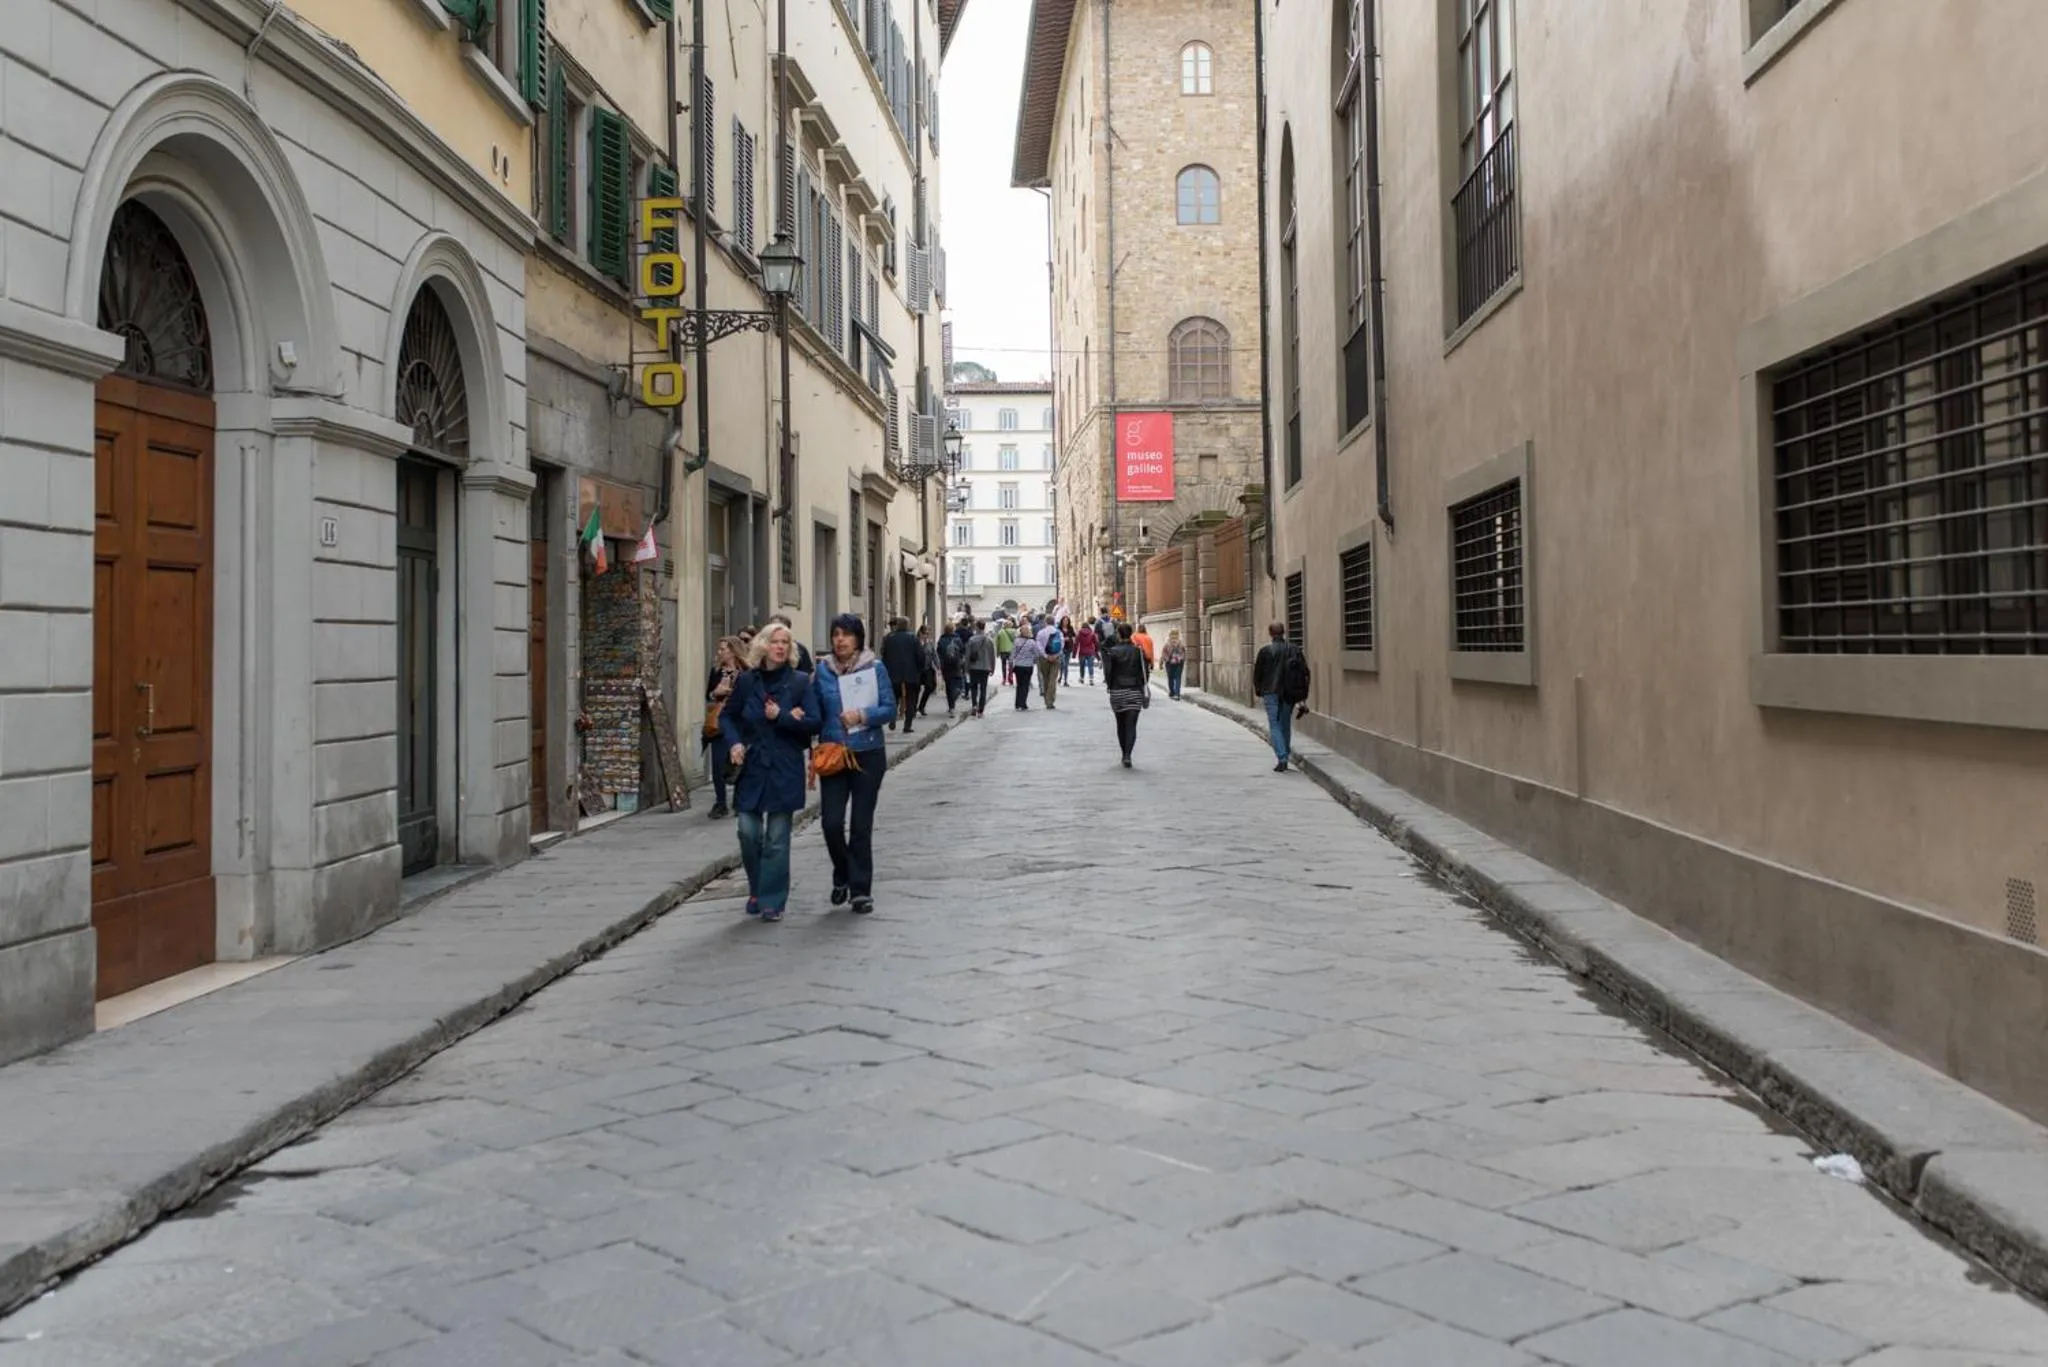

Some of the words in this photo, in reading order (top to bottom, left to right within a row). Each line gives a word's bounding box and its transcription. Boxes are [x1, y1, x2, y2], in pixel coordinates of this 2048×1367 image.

[642, 197, 685, 407] FOTO
[1127, 451, 1163, 460] museo
[1127, 463, 1163, 476] galileo
